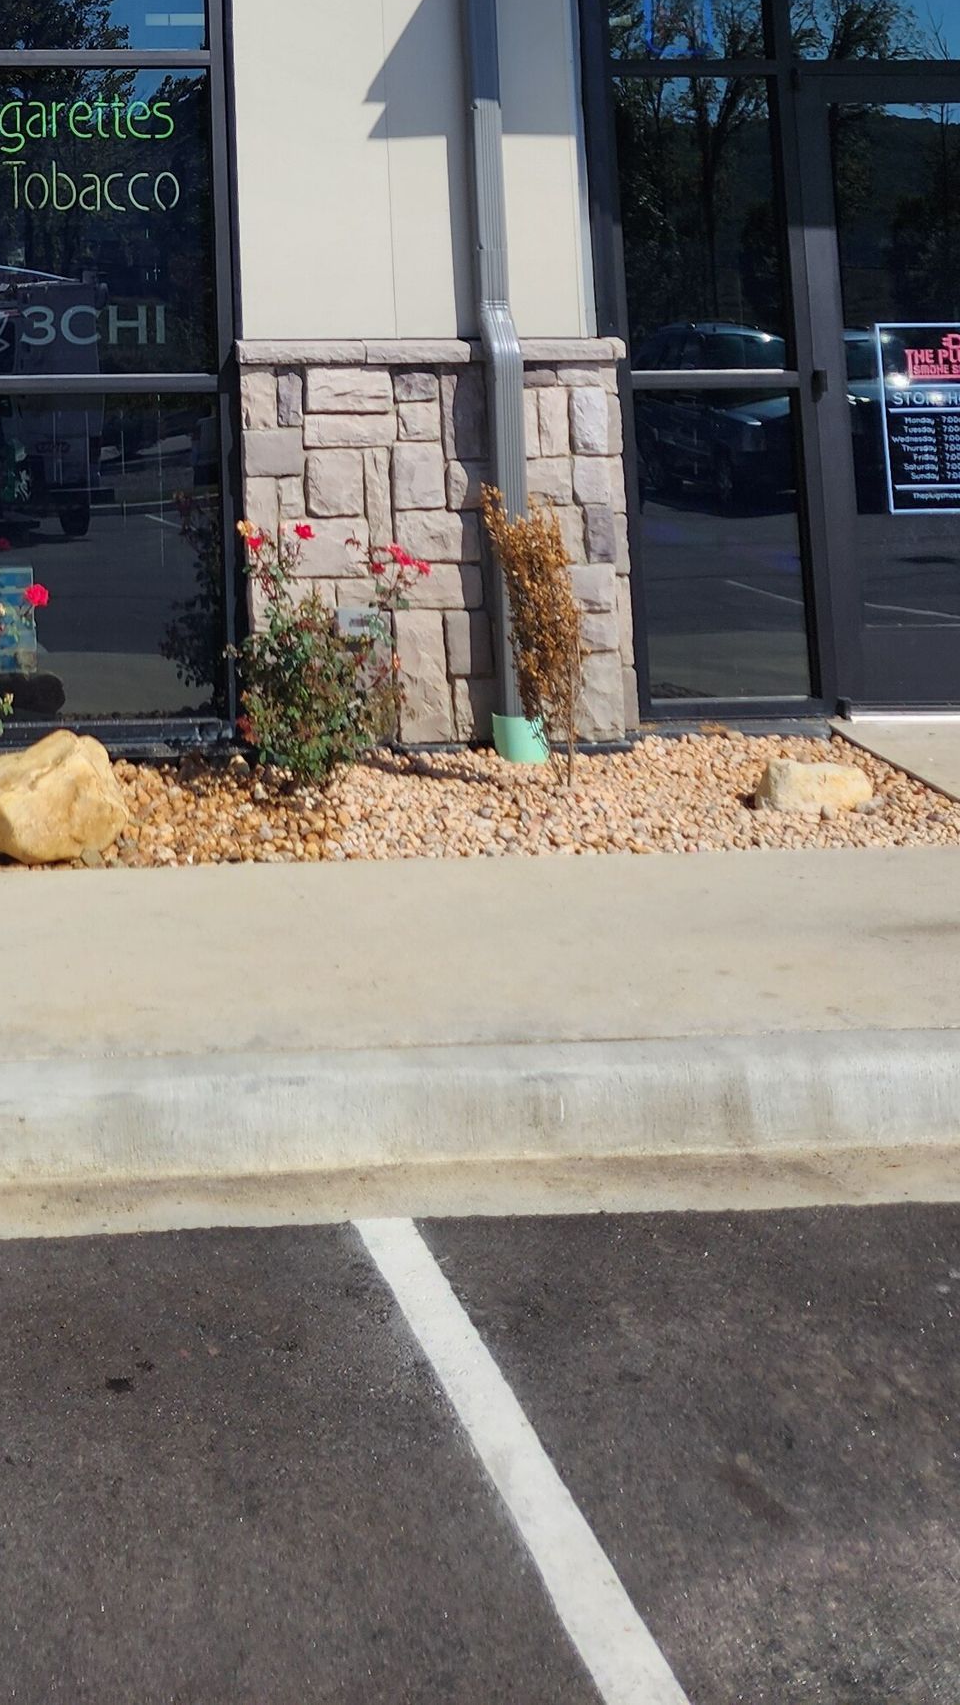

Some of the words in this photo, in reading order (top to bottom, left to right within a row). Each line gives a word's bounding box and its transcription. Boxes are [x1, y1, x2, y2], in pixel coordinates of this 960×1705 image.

[2, 160, 181, 212] Tobacco
[19, 304, 167, 346] 3CHI
[904, 348, 935, 365] THE
[913, 364, 950, 375] SMOKE
[904, 416, 935, 425] Monday
[903, 425, 935, 434] Tuesday
[891, 435, 936, 443] Wednesday
[901, 444, 937, 452] Thursday
[913, 453, 938, 462] Friday
[903, 463, 938, 471] Saturday
[911, 472, 939, 481] Sunday
